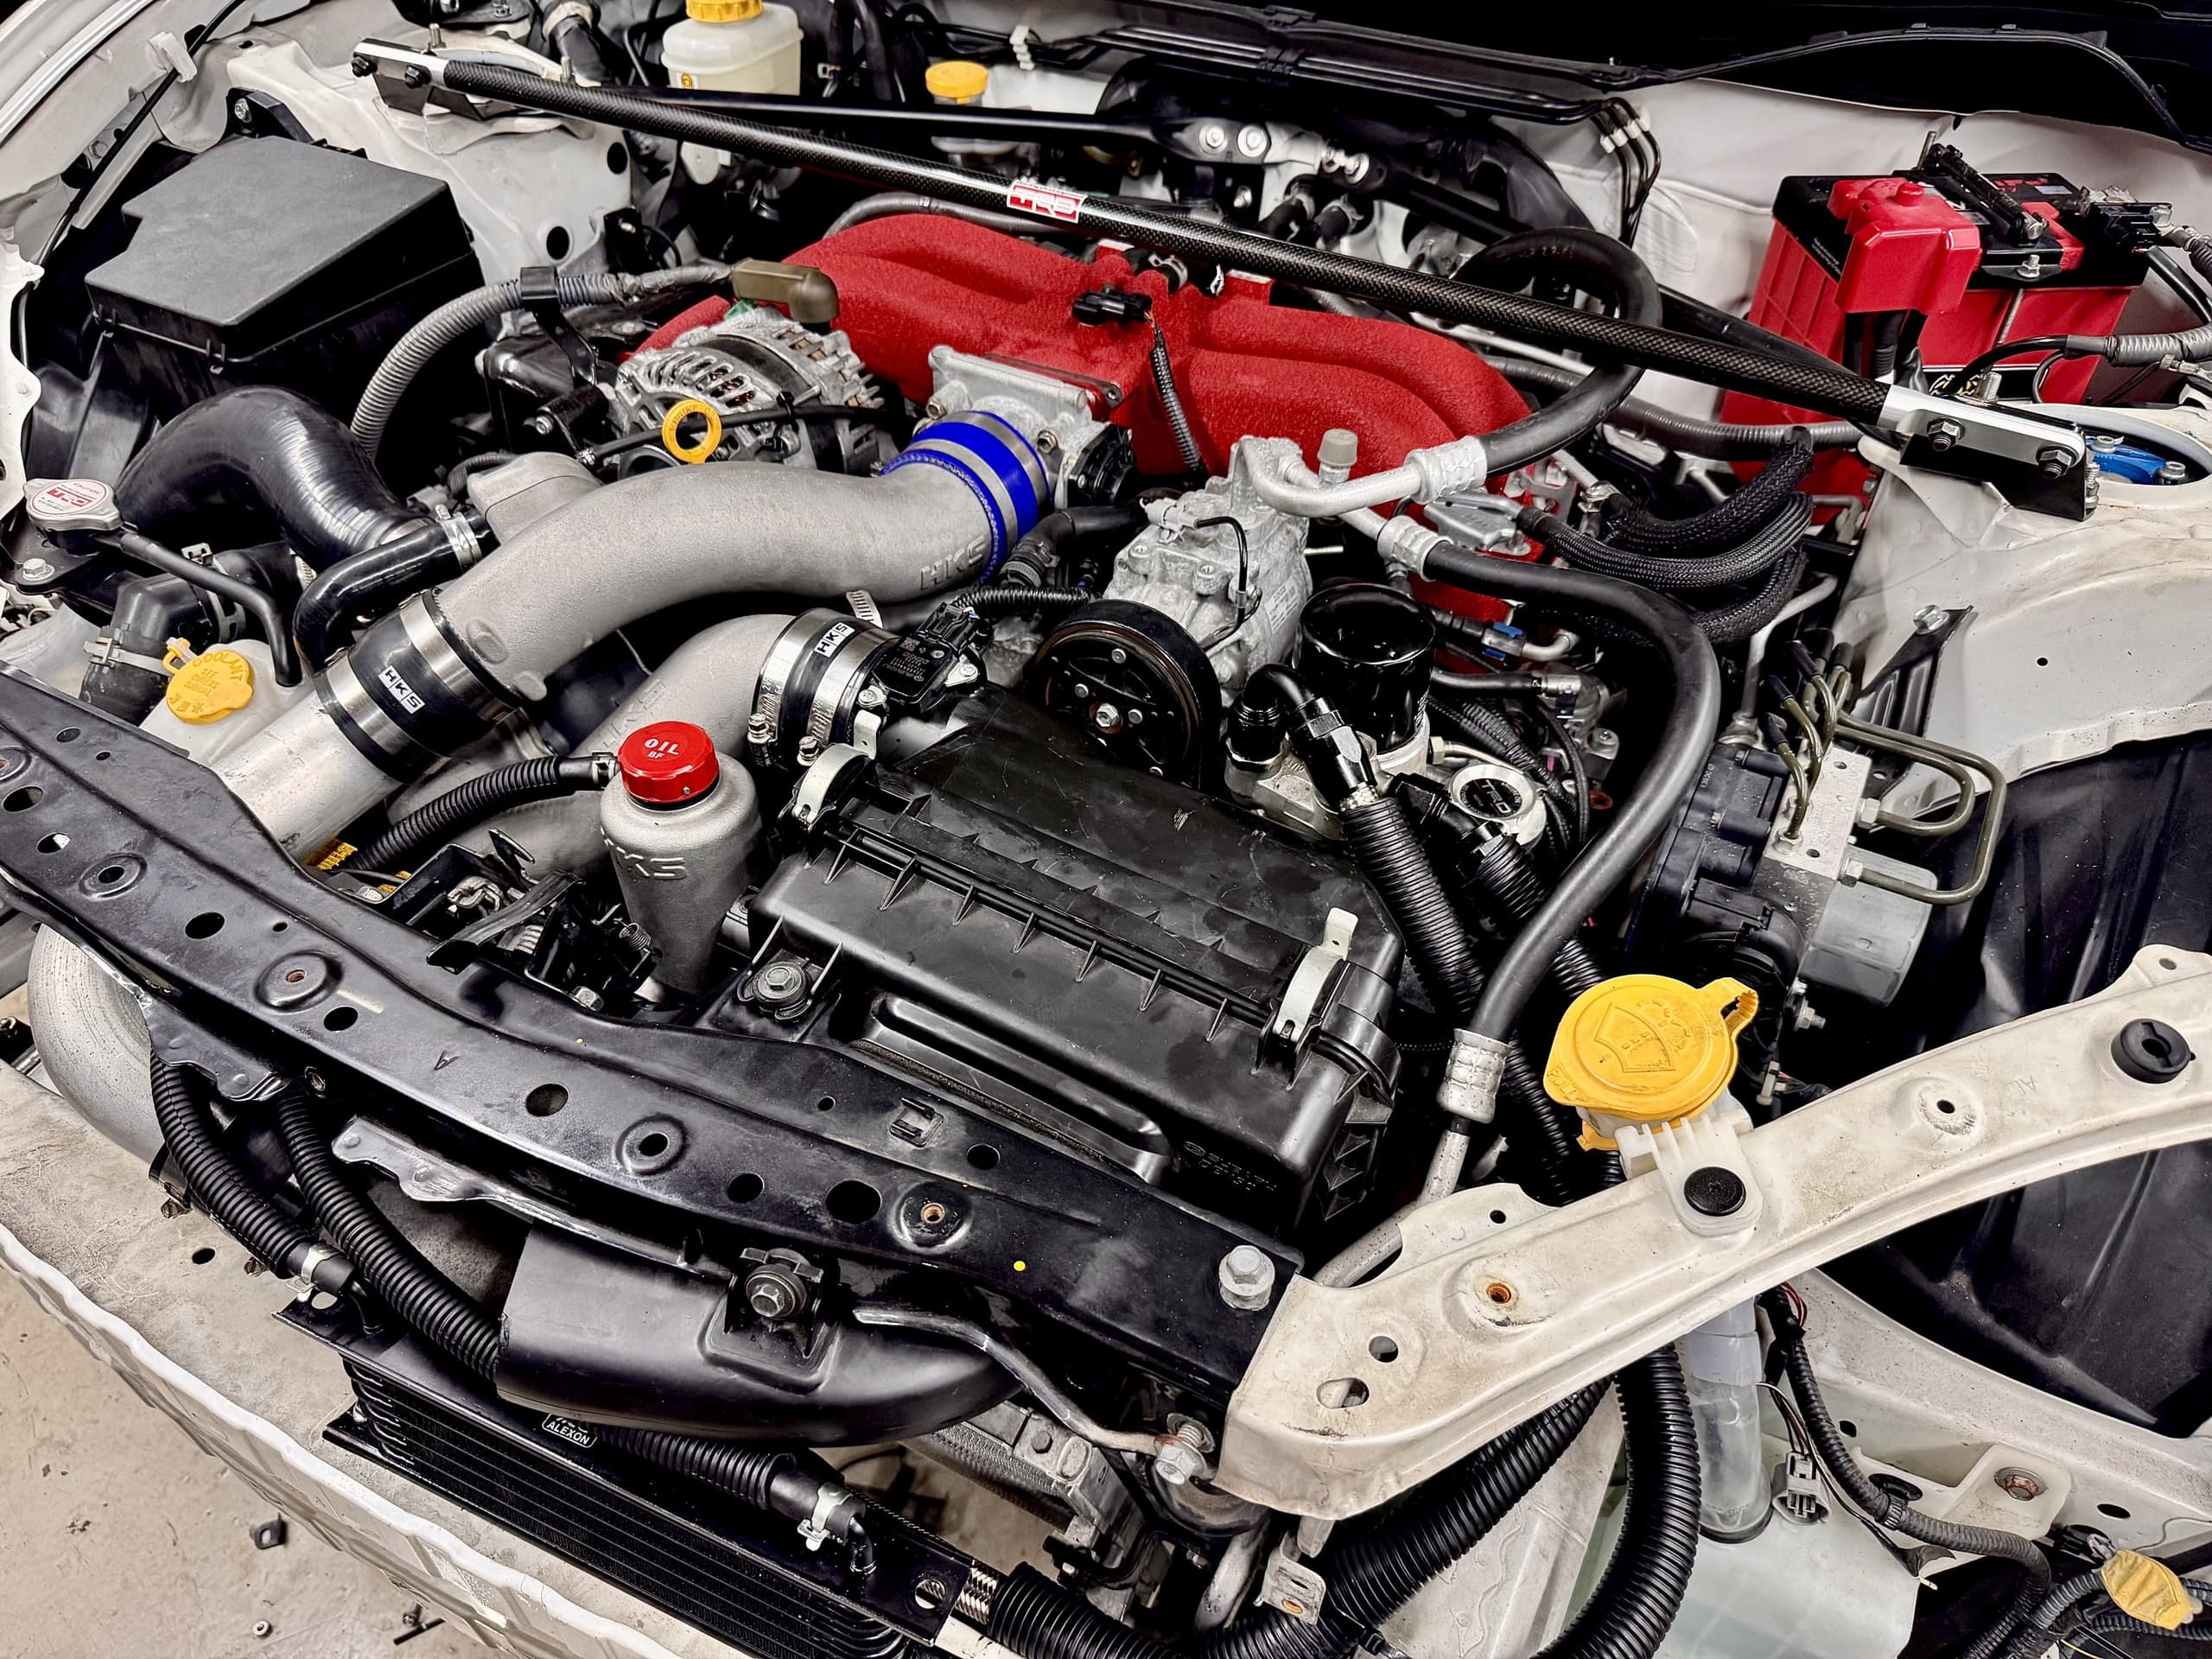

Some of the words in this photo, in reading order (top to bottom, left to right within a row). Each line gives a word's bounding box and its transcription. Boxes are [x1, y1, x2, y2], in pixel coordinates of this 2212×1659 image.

[1008, 186, 1077, 220] TRD
[919, 535, 986, 590] HKS
[816, 623, 849, 653] HKS
[193, 652, 244, 682] COOLANT
[385, 669, 422, 709] HKS
[644, 738, 679, 756] OIL
[1481, 779, 1512, 813] TRD
[545, 1421, 590, 1446] ALEXON
